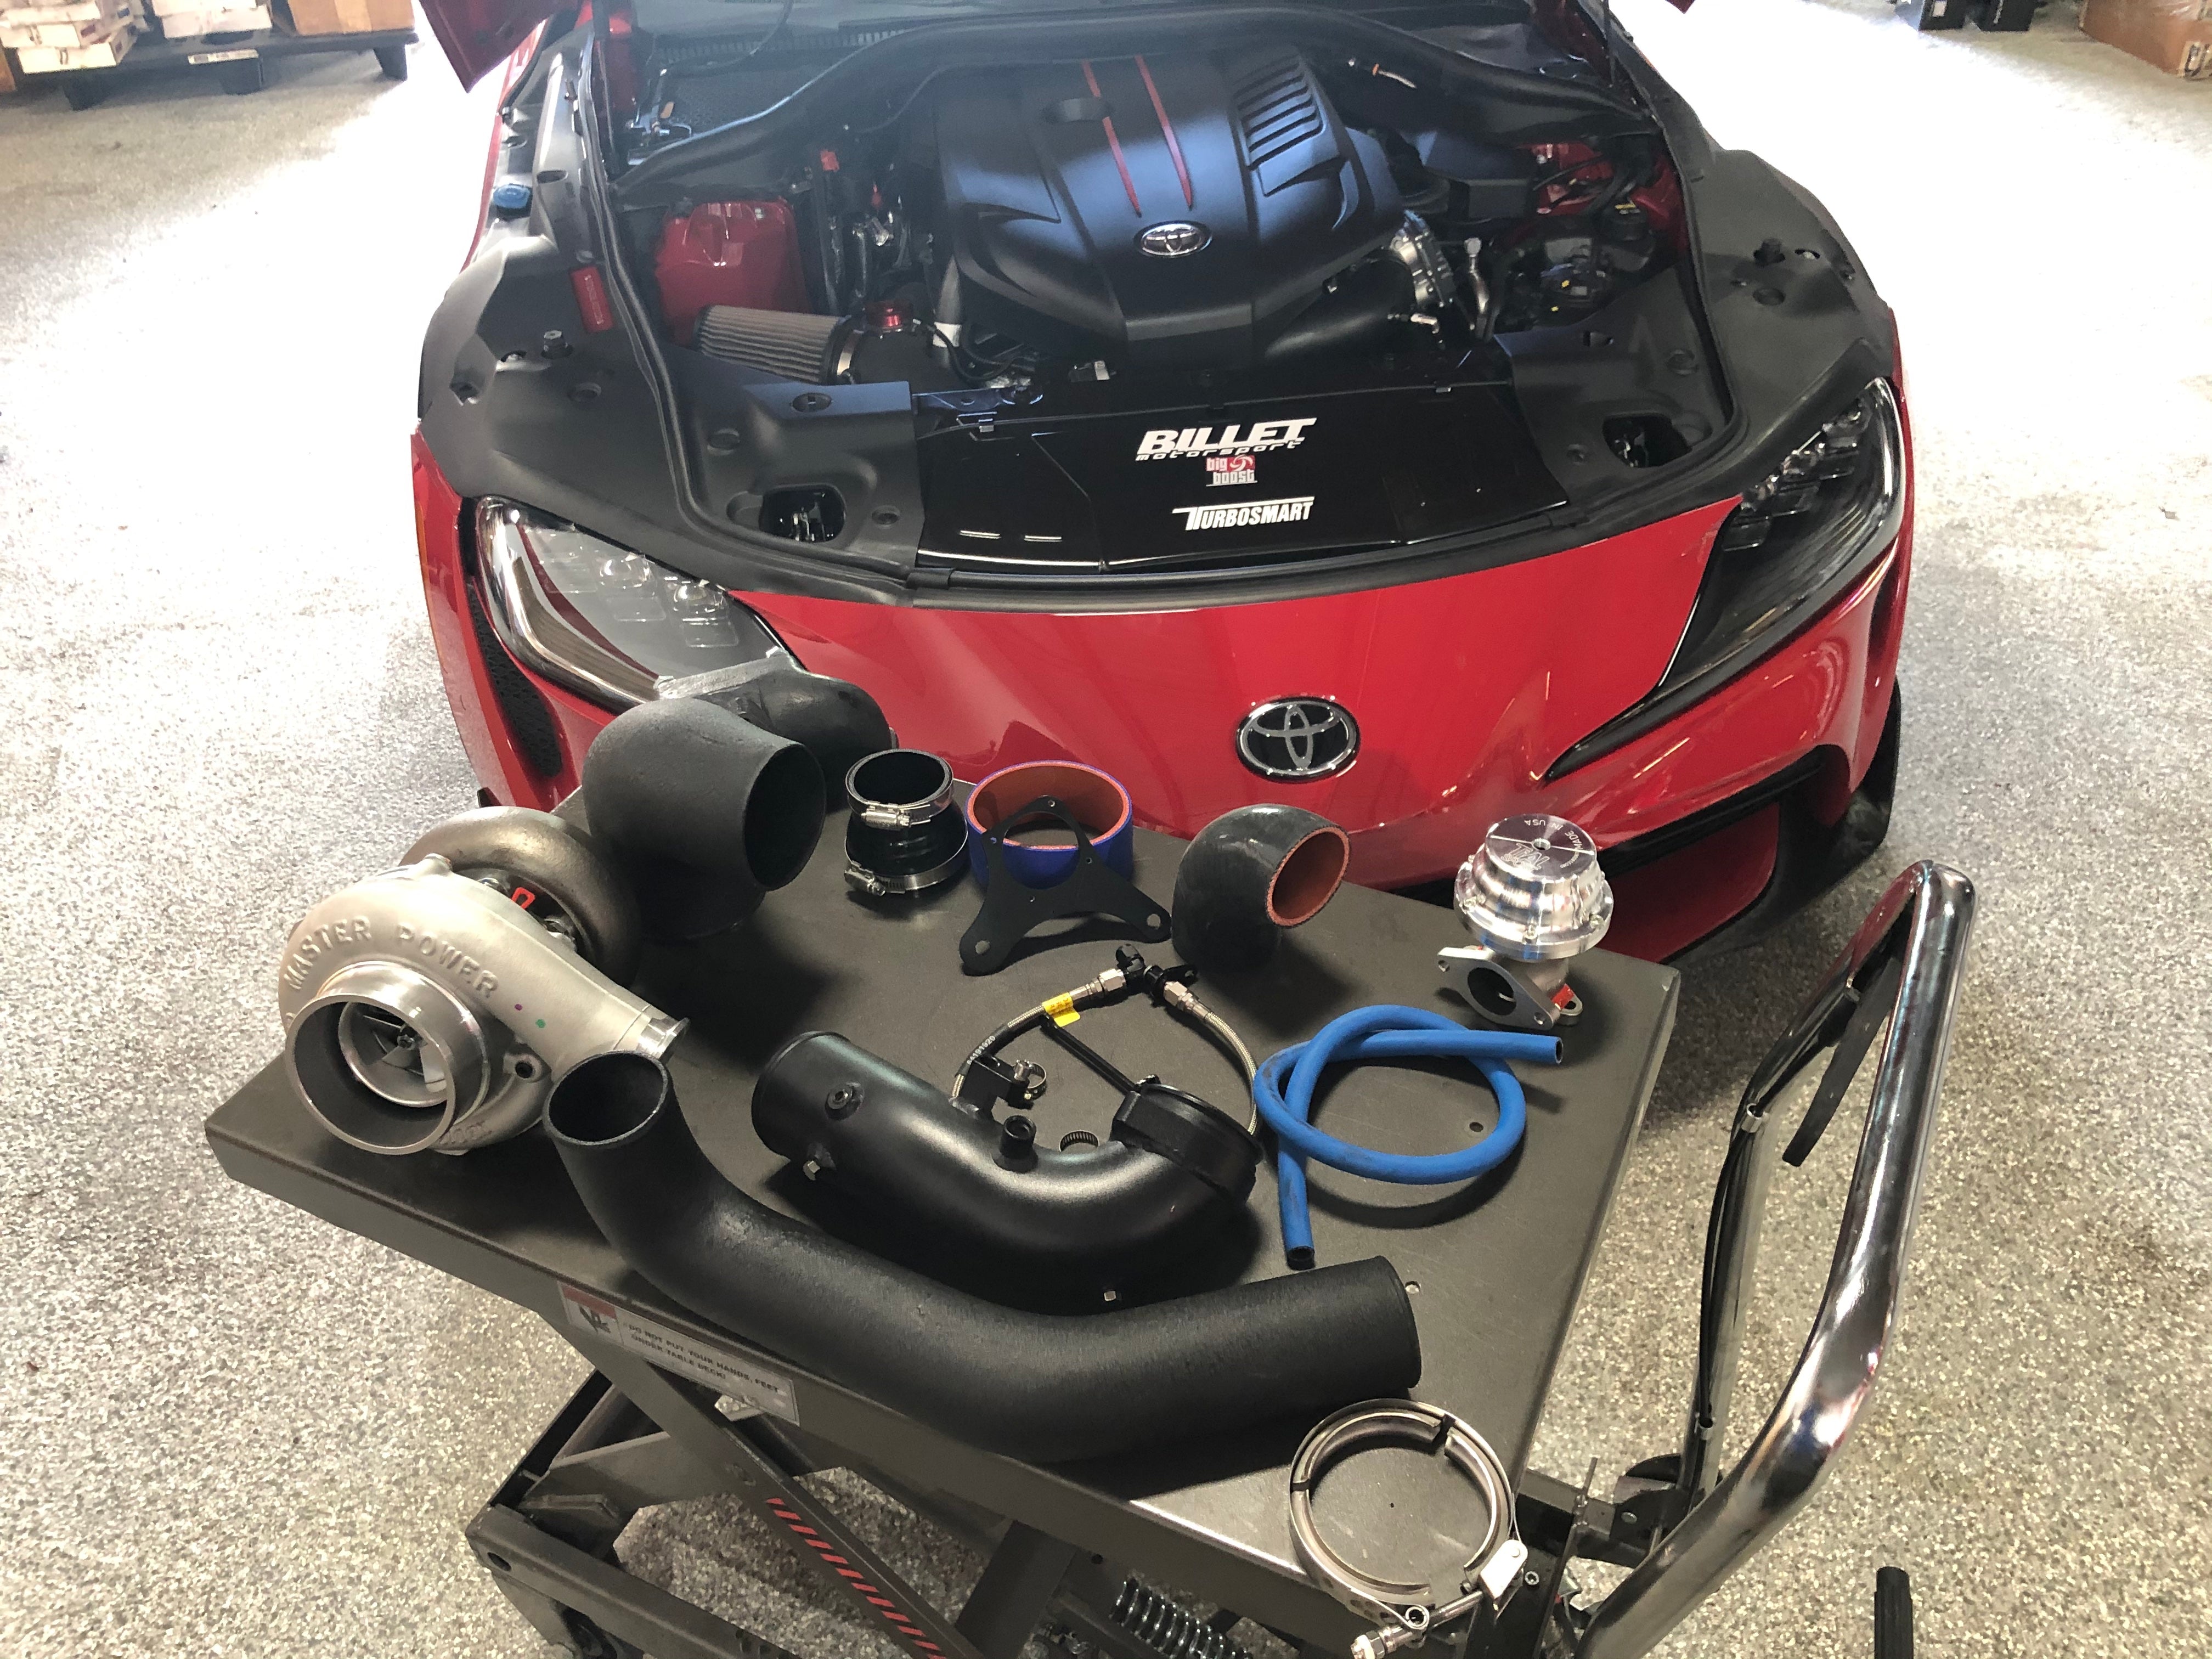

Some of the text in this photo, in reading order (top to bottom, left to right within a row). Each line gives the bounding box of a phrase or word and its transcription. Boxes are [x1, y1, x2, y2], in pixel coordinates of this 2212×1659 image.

[1136, 417, 1317, 455] BILLET
[1135, 440, 1302, 462] motorsport
[1206, 456, 1228, 472] big
[1212, 469, 1256, 484] boost
[1172, 496, 1315, 531] TURBOSMART
[1551, 822, 1564, 831] IN
[283, 915, 499, 999] MASTER POWER
